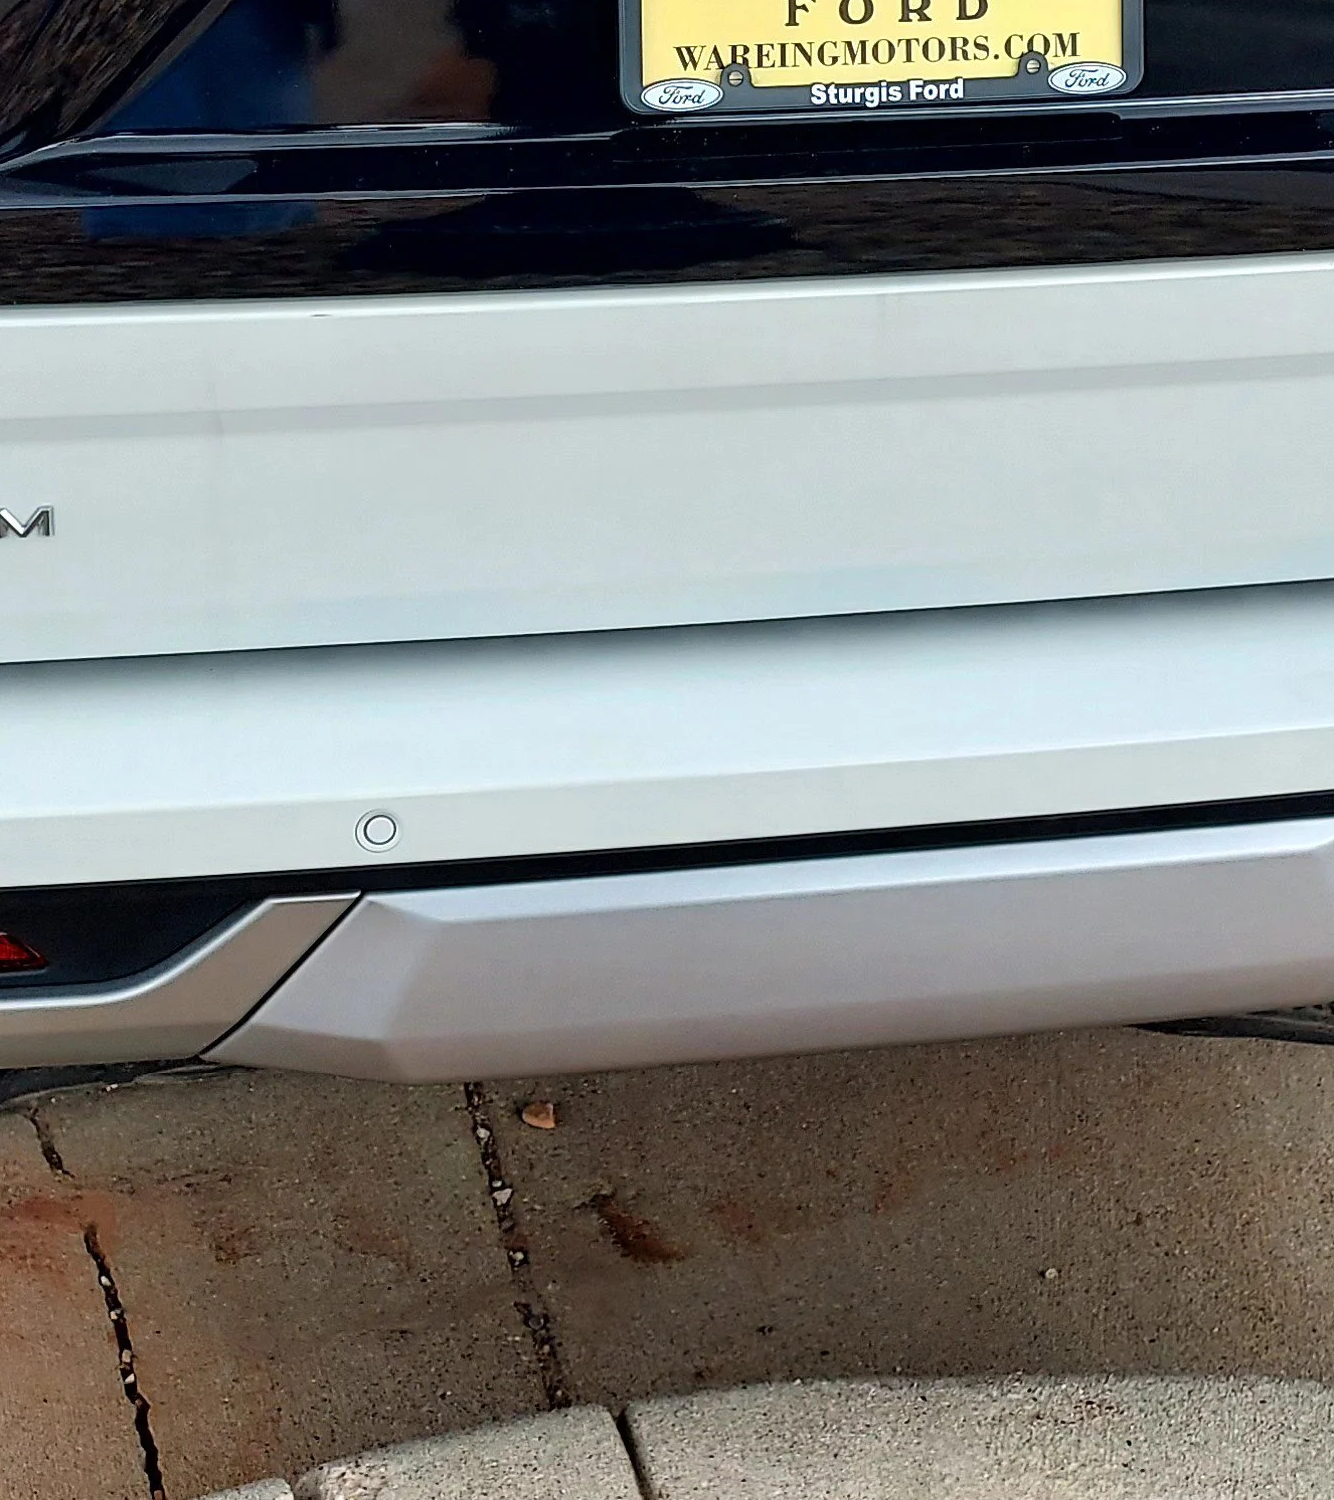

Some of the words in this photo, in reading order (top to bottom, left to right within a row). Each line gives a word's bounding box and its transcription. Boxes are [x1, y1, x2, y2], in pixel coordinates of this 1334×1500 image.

[673, 31, 1081, 71] WAREINGMOTORS.COM
[1064, 68, 1111, 88] Ford
[658, 85, 706, 105] Ford
[810, 80, 902, 109] Sturgis
[908, 78, 964, 102] Ford
